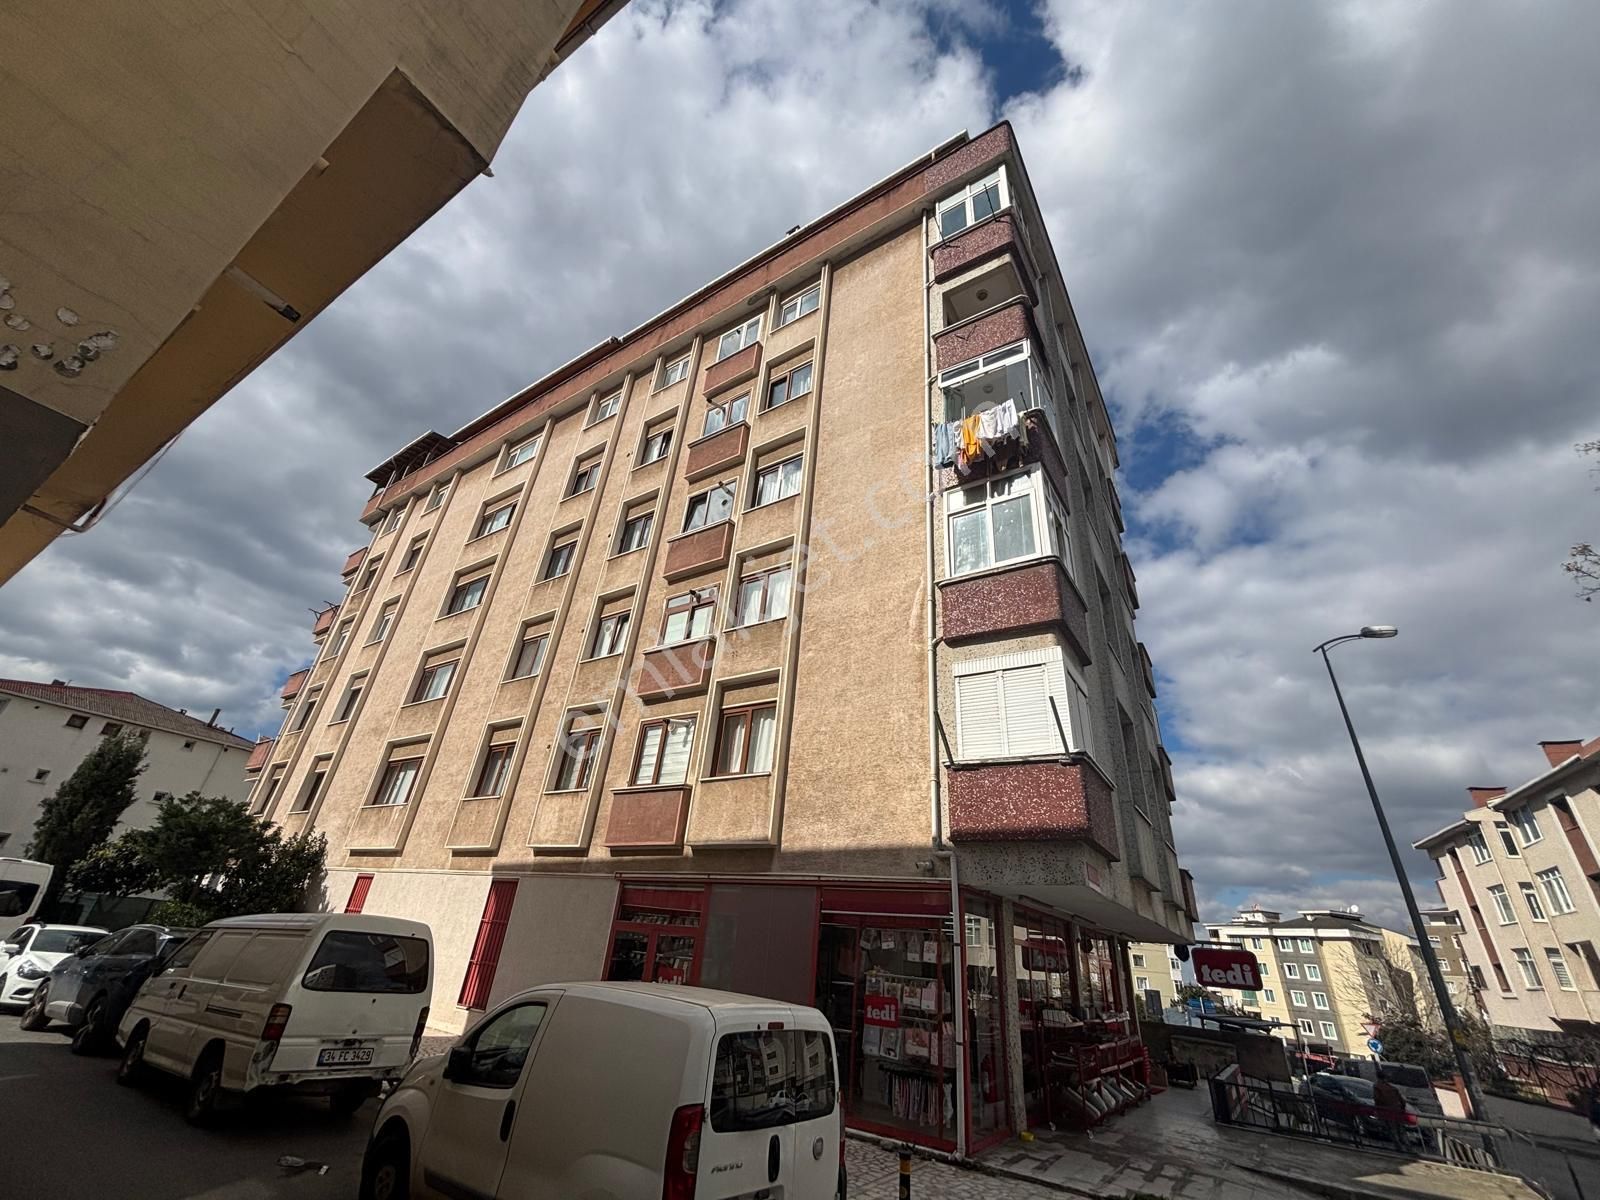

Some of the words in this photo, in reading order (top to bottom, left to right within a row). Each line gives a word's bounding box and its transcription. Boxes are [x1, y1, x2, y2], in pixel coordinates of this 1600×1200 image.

[1201, 963, 1255, 986] tedi
[866, 1004, 896, 1021] tedi
[325, 1051, 335, 1062] 34
[338, 1051, 350, 1061] FC
